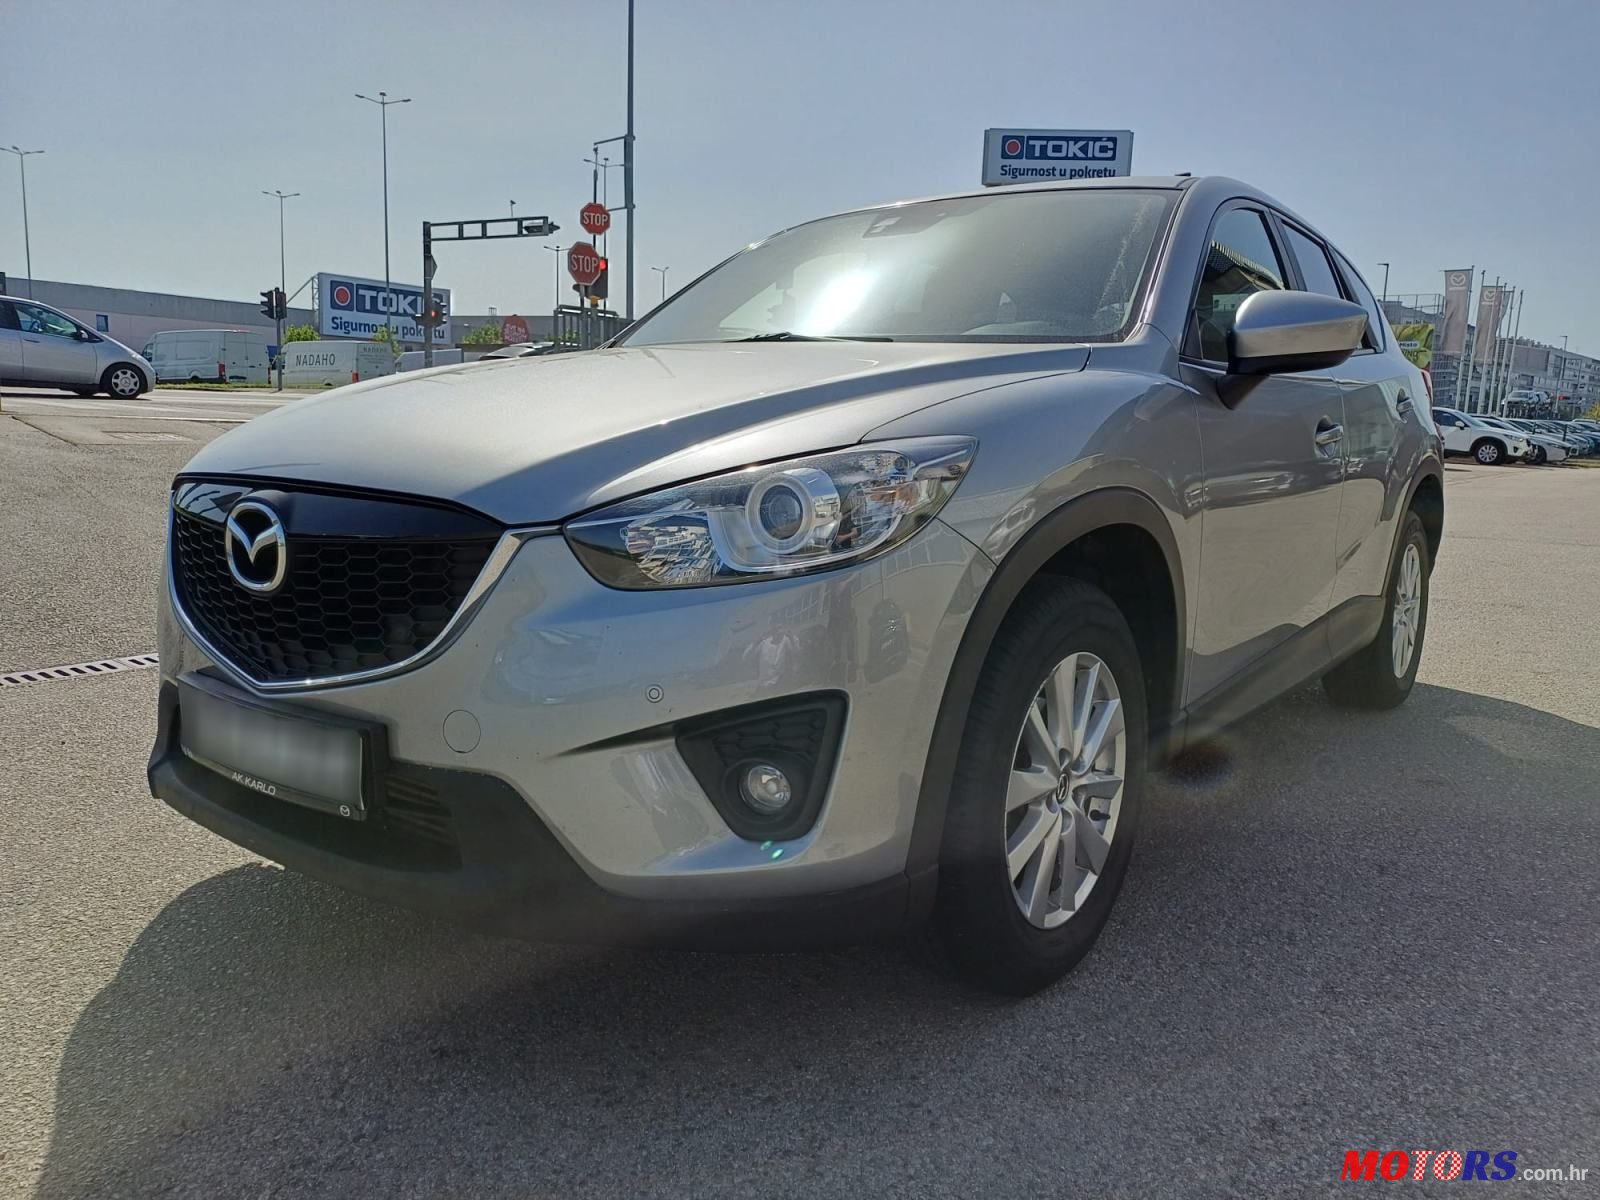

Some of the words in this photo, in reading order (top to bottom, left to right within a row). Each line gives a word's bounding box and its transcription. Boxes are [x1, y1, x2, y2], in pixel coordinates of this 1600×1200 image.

[1028, 138, 1114, 158] TOKIĆ
[1000, 164, 1057, 179] Sigurnost
[1059, 167, 1067, 177] u
[1069, 165, 1117, 179] pokretu
[583, 211, 609, 227] STOP
[571, 254, 599, 273] STOP
[358, 288, 442, 315] TOKI
[331, 316, 388, 335] Sigurno
[402, 324, 445, 339] poktu
[295, 353, 336, 367] NADAHO
[231, 771, 245, 785] AK
[244, 777, 276, 796] KARLO
